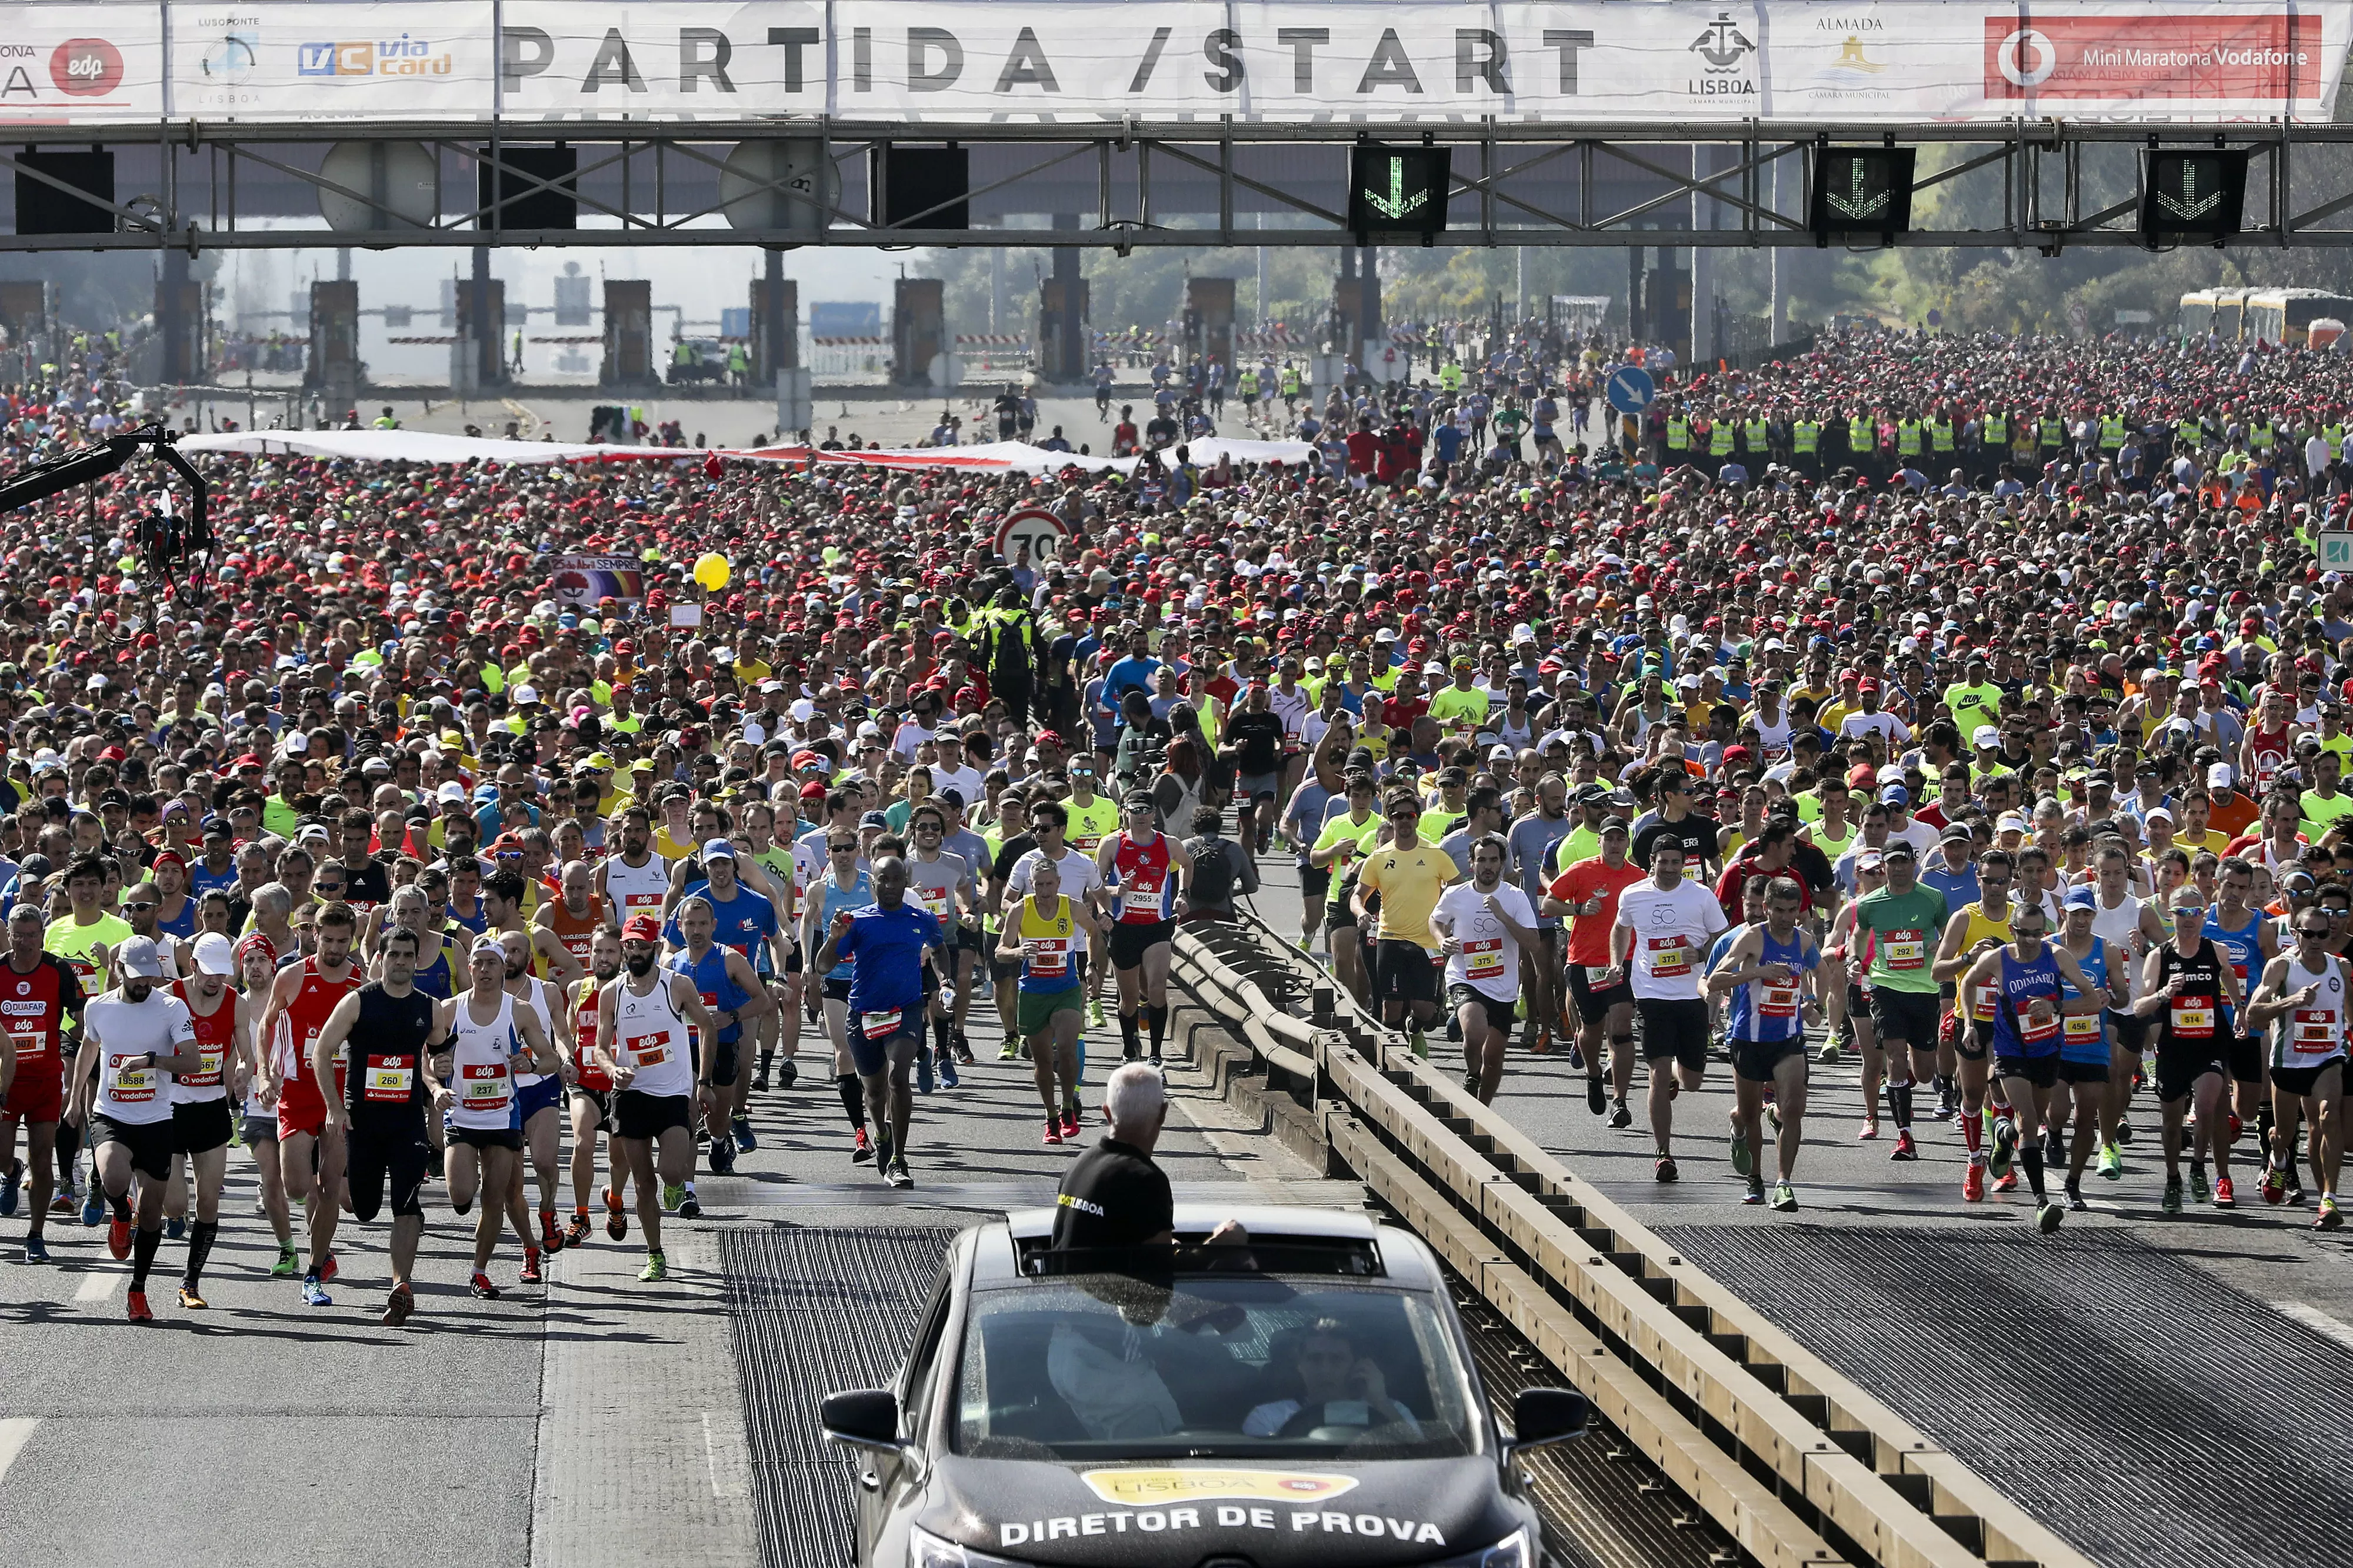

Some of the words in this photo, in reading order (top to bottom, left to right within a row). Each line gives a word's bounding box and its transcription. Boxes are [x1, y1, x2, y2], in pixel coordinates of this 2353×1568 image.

[198, 18, 260, 27] LUSOPONTE
[1816, 18, 1884, 31] ALMADA
[379, 33, 429, 57] via
[502, 25, 1061, 94] PARTIDA
[2084, 49, 2121, 66] Mini
[2125, 48, 2211, 67] Maratona
[2214, 48, 2308, 66] Vodafone
[67, 55, 103, 80] edp
[379, 54, 451, 75] card
[1688, 79, 1755, 95] LISBOA
[198, 95, 261, 104] LISBOA
[1808, 90, 1844, 99] CÂMARA
[1845, 91, 1891, 99] MUNICIPAL
[1011, 533, 1055, 561] 70
[1962, 694, 1982, 703] RUN
[1084, 840, 1098, 848] edp
[1138, 882, 1152, 892] edp
[922, 889, 936, 899] edp
[1133, 894, 1152, 902] 2955
[636, 895, 652, 905] edp
[354, 900, 369, 912] edp
[1651, 909, 1676, 925] SC
[1473, 918, 1497, 933] SC
[1894, 930, 1911, 942] edp
[571, 942, 588, 955] edp
[1041, 940, 1056, 950] edp
[1475, 941, 1491, 950] edp
[1659, 938, 1676, 948] edp
[1478, 957, 1491, 965] 375
[1662, 955, 1676, 963] 373
[72, 965, 83, 976] dp
[2009, 972, 2055, 994] ODIMARQ
[2184, 997, 2202, 1009] edp
[2184, 1015, 2199, 1023] 514
[2309, 1010, 2326, 1023] edp
[15, 1019, 33, 1032] edp
[871, 1026, 891, 1036] Santander
[2071, 1022, 2087, 1030] 456
[15, 1039, 31, 1047] 607
[638, 1035, 658, 1049] edp
[382, 1056, 402, 1069] edp
[475, 1065, 494, 1079] edp
[118, 1076, 145, 1085] 19588
[381, 1076, 398, 1085] 260
[476, 1086, 493, 1095] 237
[1114, 1478, 1258, 1493] LISBOA
[1000, 1507, 1199, 1548] DIRETOR
[1218, 1506, 1276, 1530] DE
[1292, 1511, 1447, 1548] PROVA
